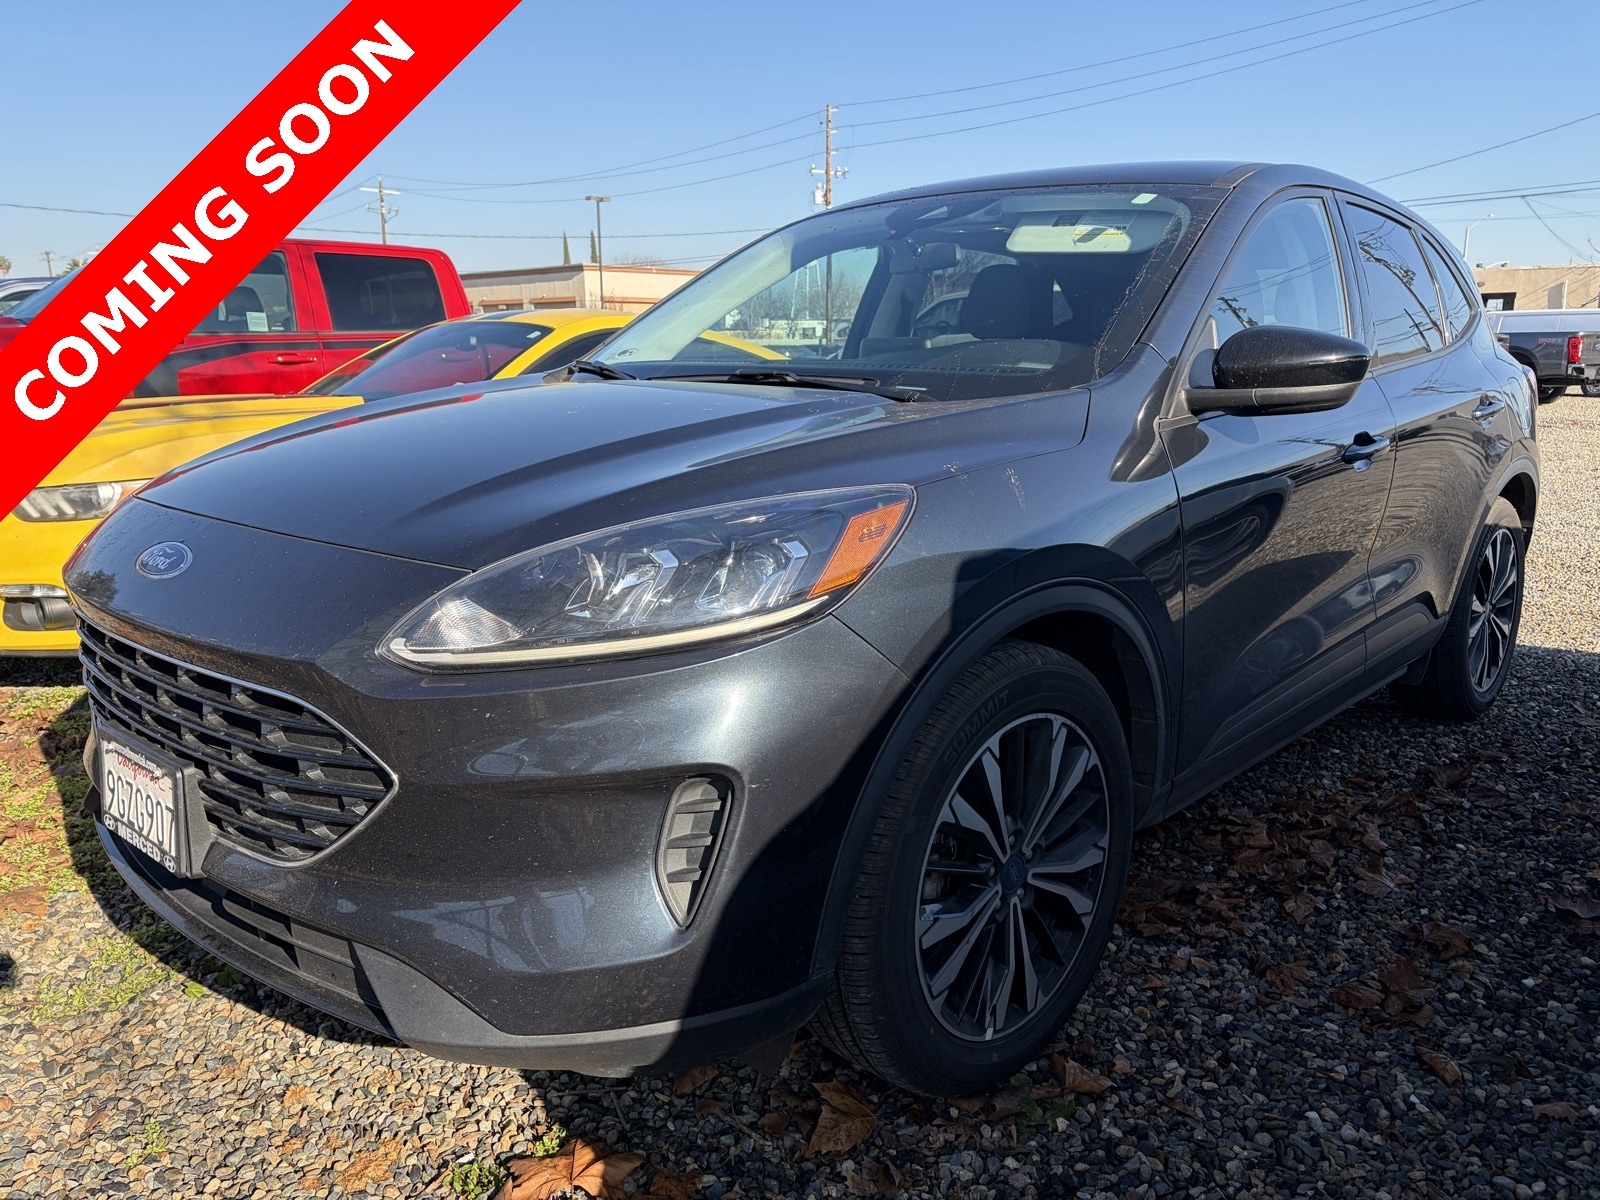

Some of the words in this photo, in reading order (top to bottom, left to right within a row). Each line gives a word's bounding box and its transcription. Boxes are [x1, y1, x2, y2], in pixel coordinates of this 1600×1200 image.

[144, 546, 177, 570] Ford
[944, 689, 1009, 768] SUMMIT
[107, 769, 175, 855] 9GZG907
[117, 822, 161, 863] MERCED
